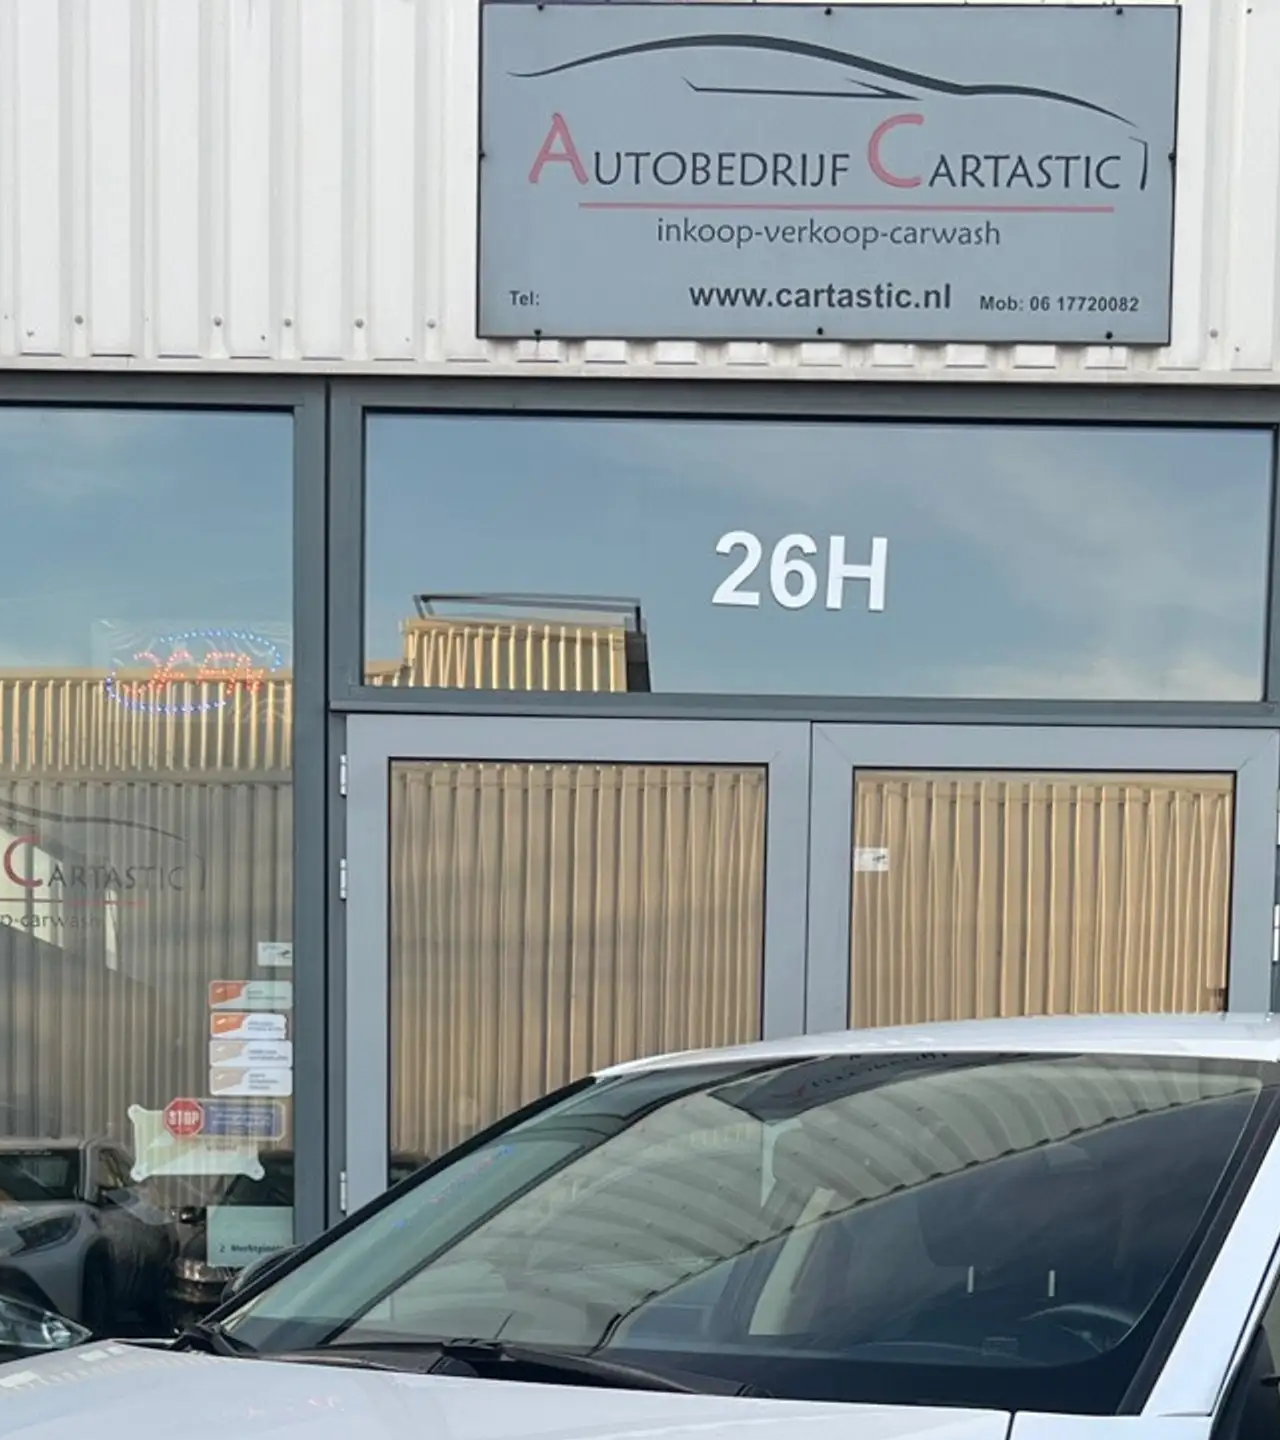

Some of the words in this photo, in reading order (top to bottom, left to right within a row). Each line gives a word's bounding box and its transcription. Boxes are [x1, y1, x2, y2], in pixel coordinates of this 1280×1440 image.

[528, 112, 851, 187] AUTOBEDRIJF
[867, 113, 1122, 189] CARTASTIC
[657, 217, 1001, 250] inkoop-verkoop-carwash
[508, 289, 541, 307] Tel:
[688, 282, 952, 309] www.cartastic.nl
[979, 295, 1024, 312] Mob:
[1029, 296, 1051, 312] 06
[1056, 295, 1140, 312] 17720082
[711, 530, 889, 612] 26H
[168, 1109, 200, 1126] STOP
